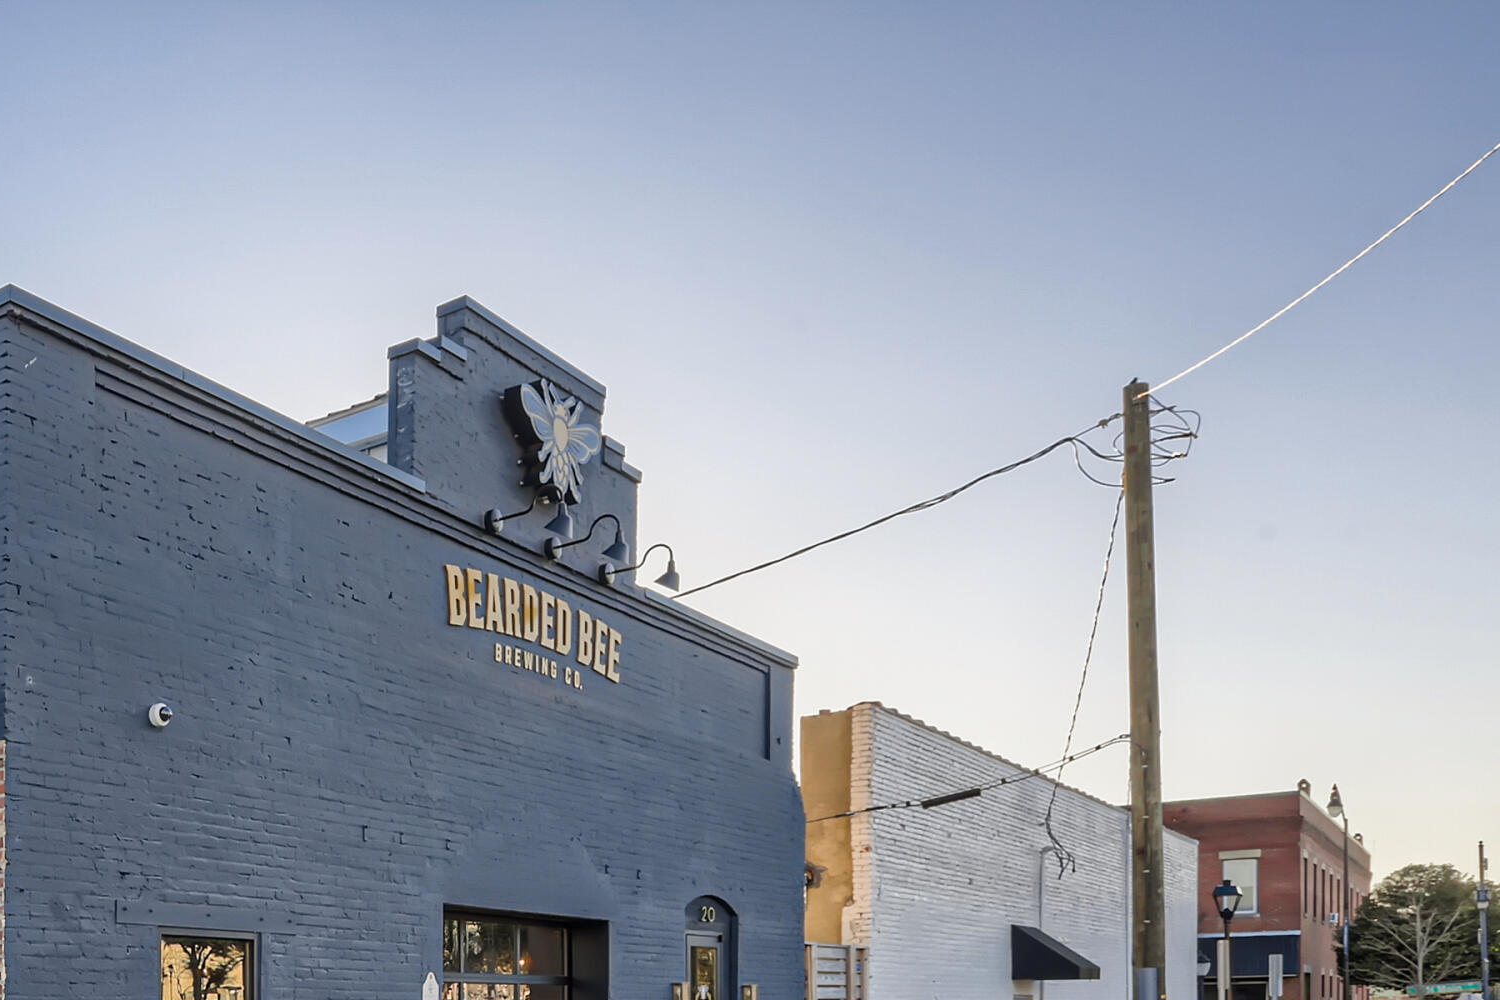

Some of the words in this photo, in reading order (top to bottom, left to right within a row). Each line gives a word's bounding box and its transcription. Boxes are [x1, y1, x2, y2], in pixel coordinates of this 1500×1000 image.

[444, 563, 573, 656] BEARDED
[577, 609, 623, 684] BEE
[494, 641, 558, 680] BREWING
[564, 665, 584, 691] CO.
[701, 905, 716, 923] 20
